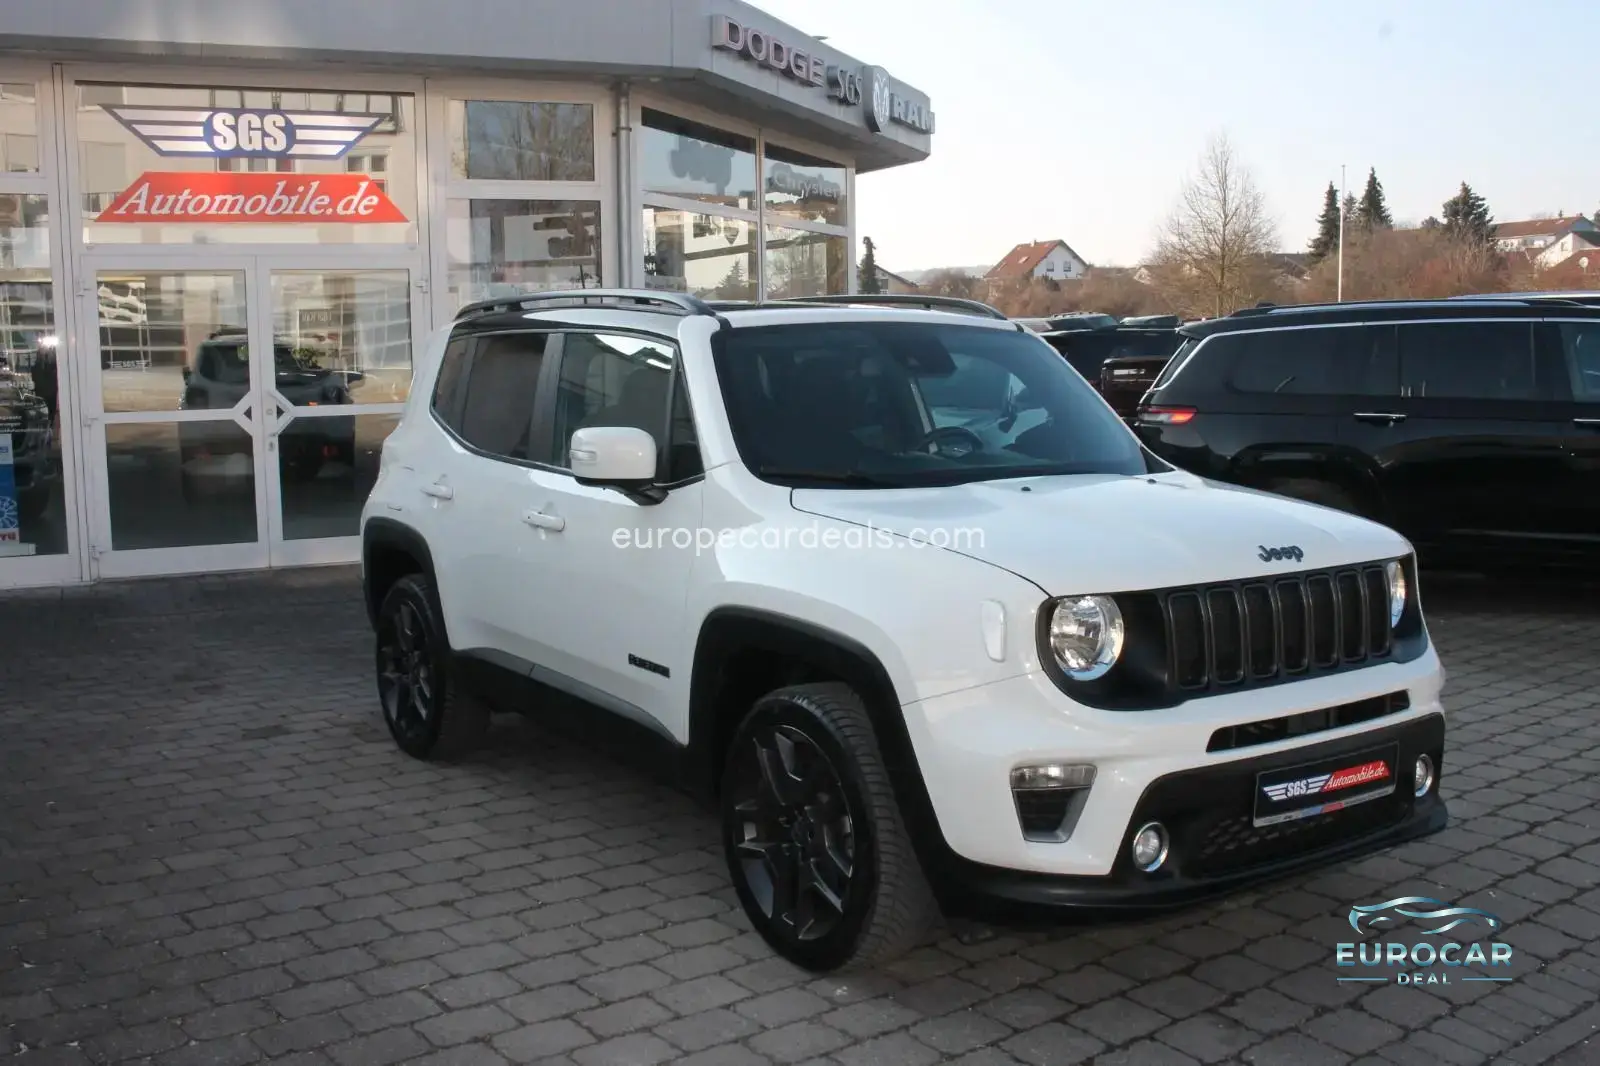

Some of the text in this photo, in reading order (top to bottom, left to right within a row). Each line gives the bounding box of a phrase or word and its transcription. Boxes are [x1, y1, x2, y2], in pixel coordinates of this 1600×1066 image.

[714, 15, 825, 88] DODGE
[830, 65, 862, 106] SGS
[212, 112, 287, 152] SGS
[889, 92, 935, 134] RAM
[113, 180, 379, 216] Automobile.de
[773, 170, 838, 198] Chrysler
[1258, 545, 1304, 563] Jeep
[1287, 760, 1385, 798] SGS Automobile.de
